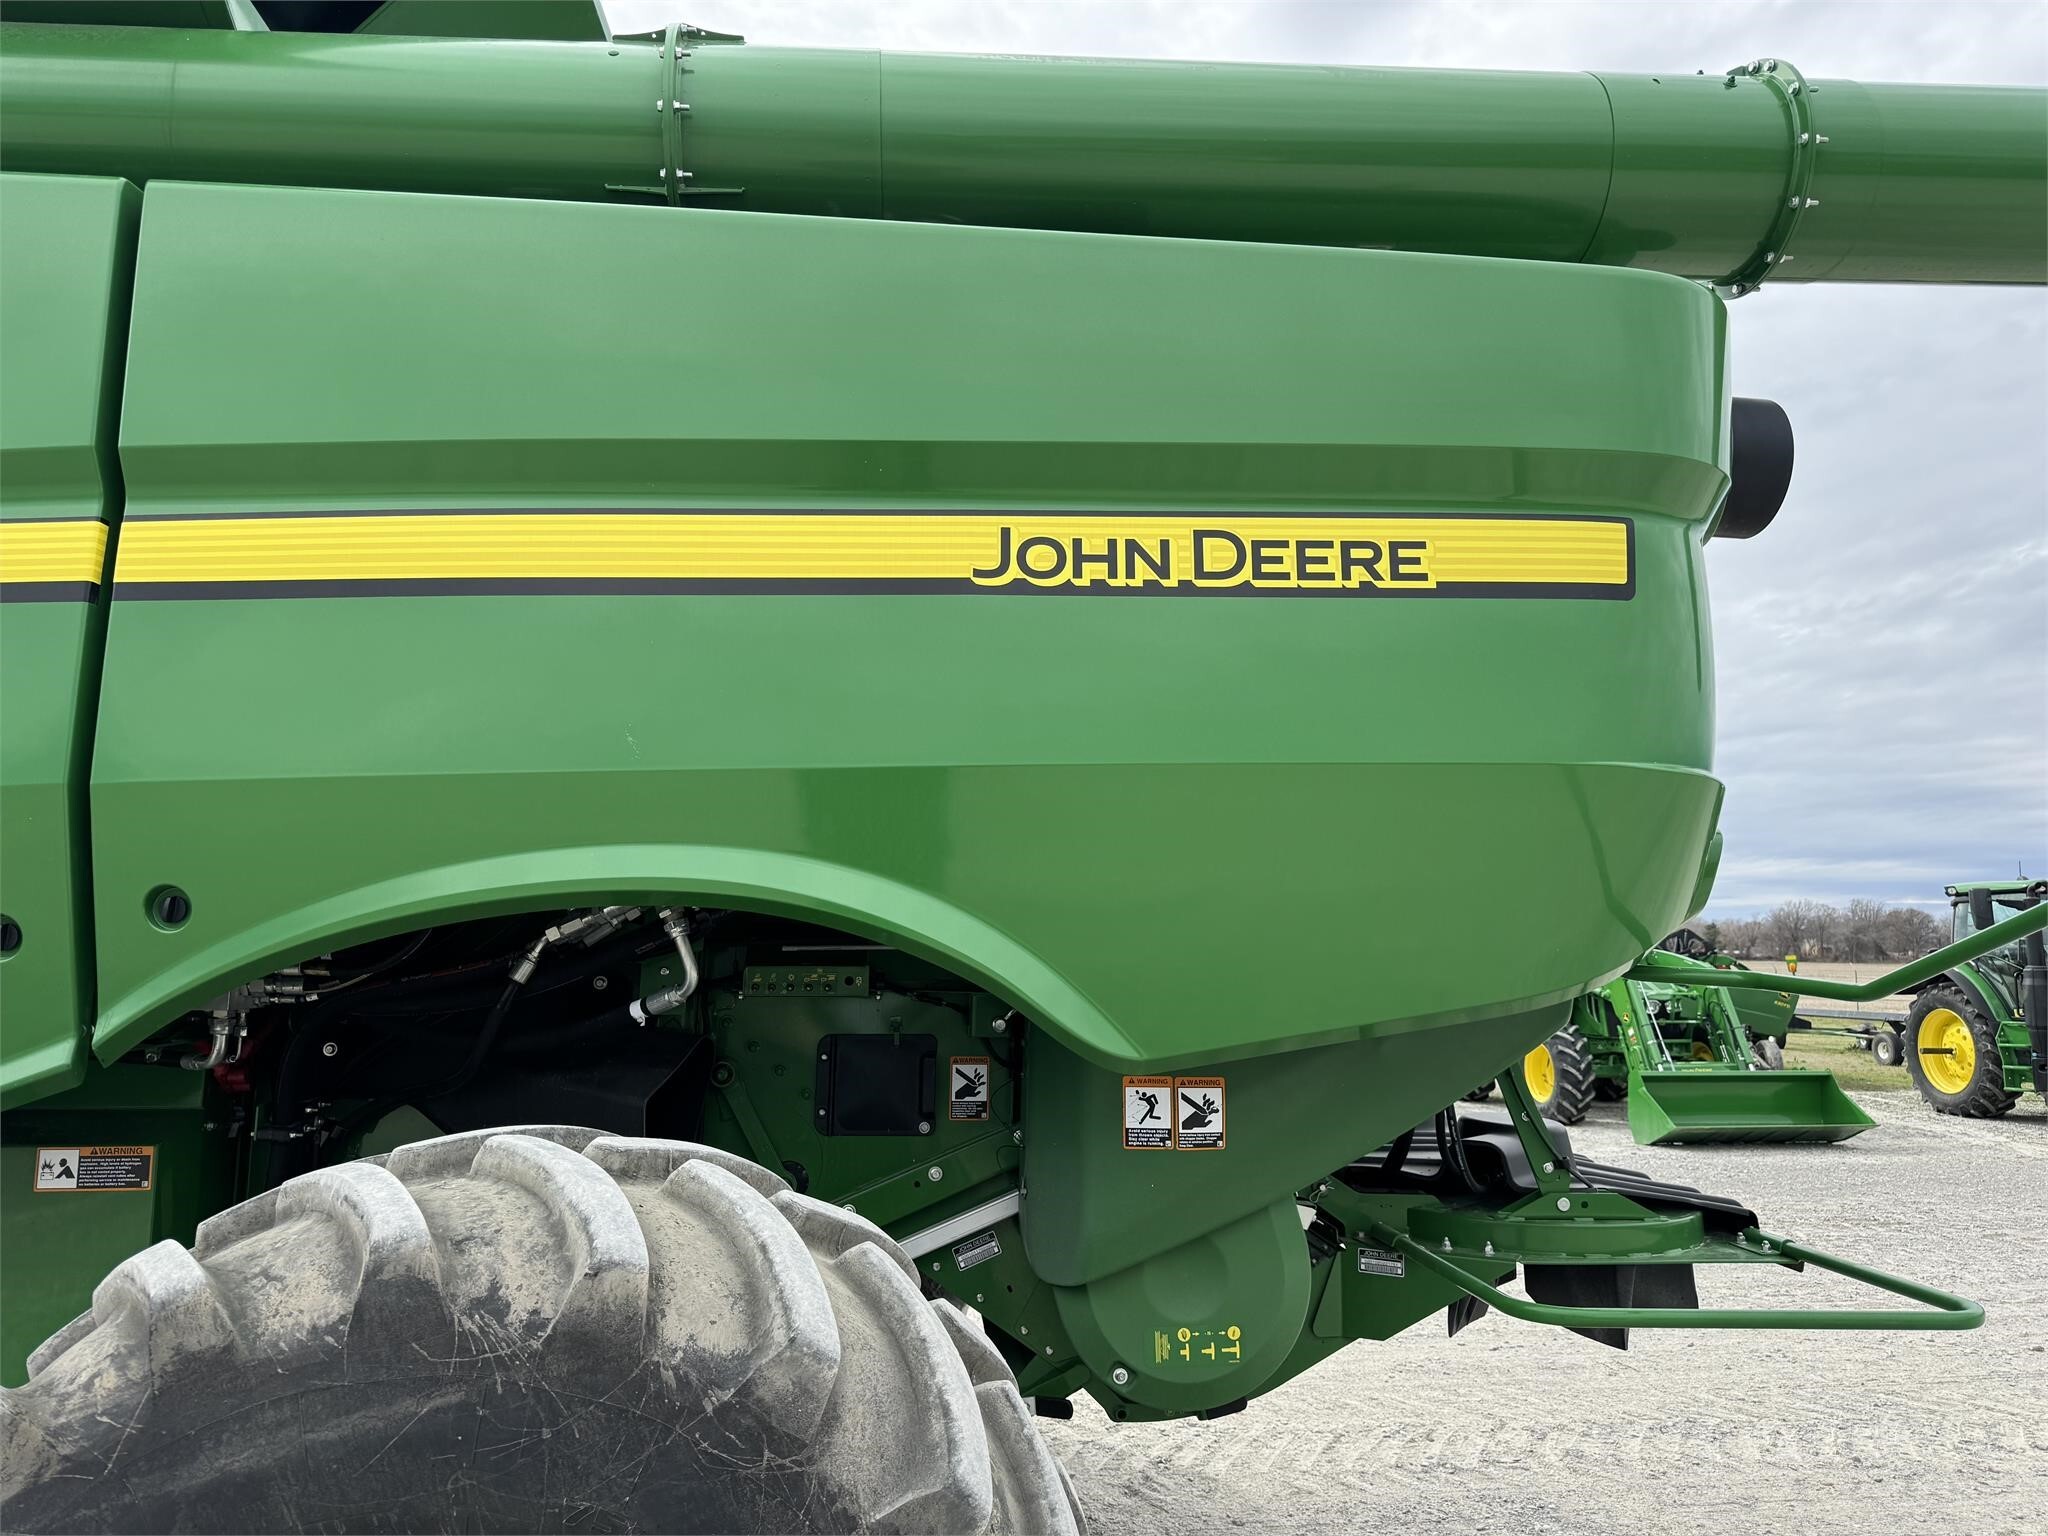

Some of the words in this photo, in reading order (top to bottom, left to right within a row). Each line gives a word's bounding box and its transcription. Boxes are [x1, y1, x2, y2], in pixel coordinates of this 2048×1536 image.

[973, 526, 1170, 580] JOHN
[1192, 529, 1429, 581] DEERE
[98, 1147, 143, 1155] WARNING
